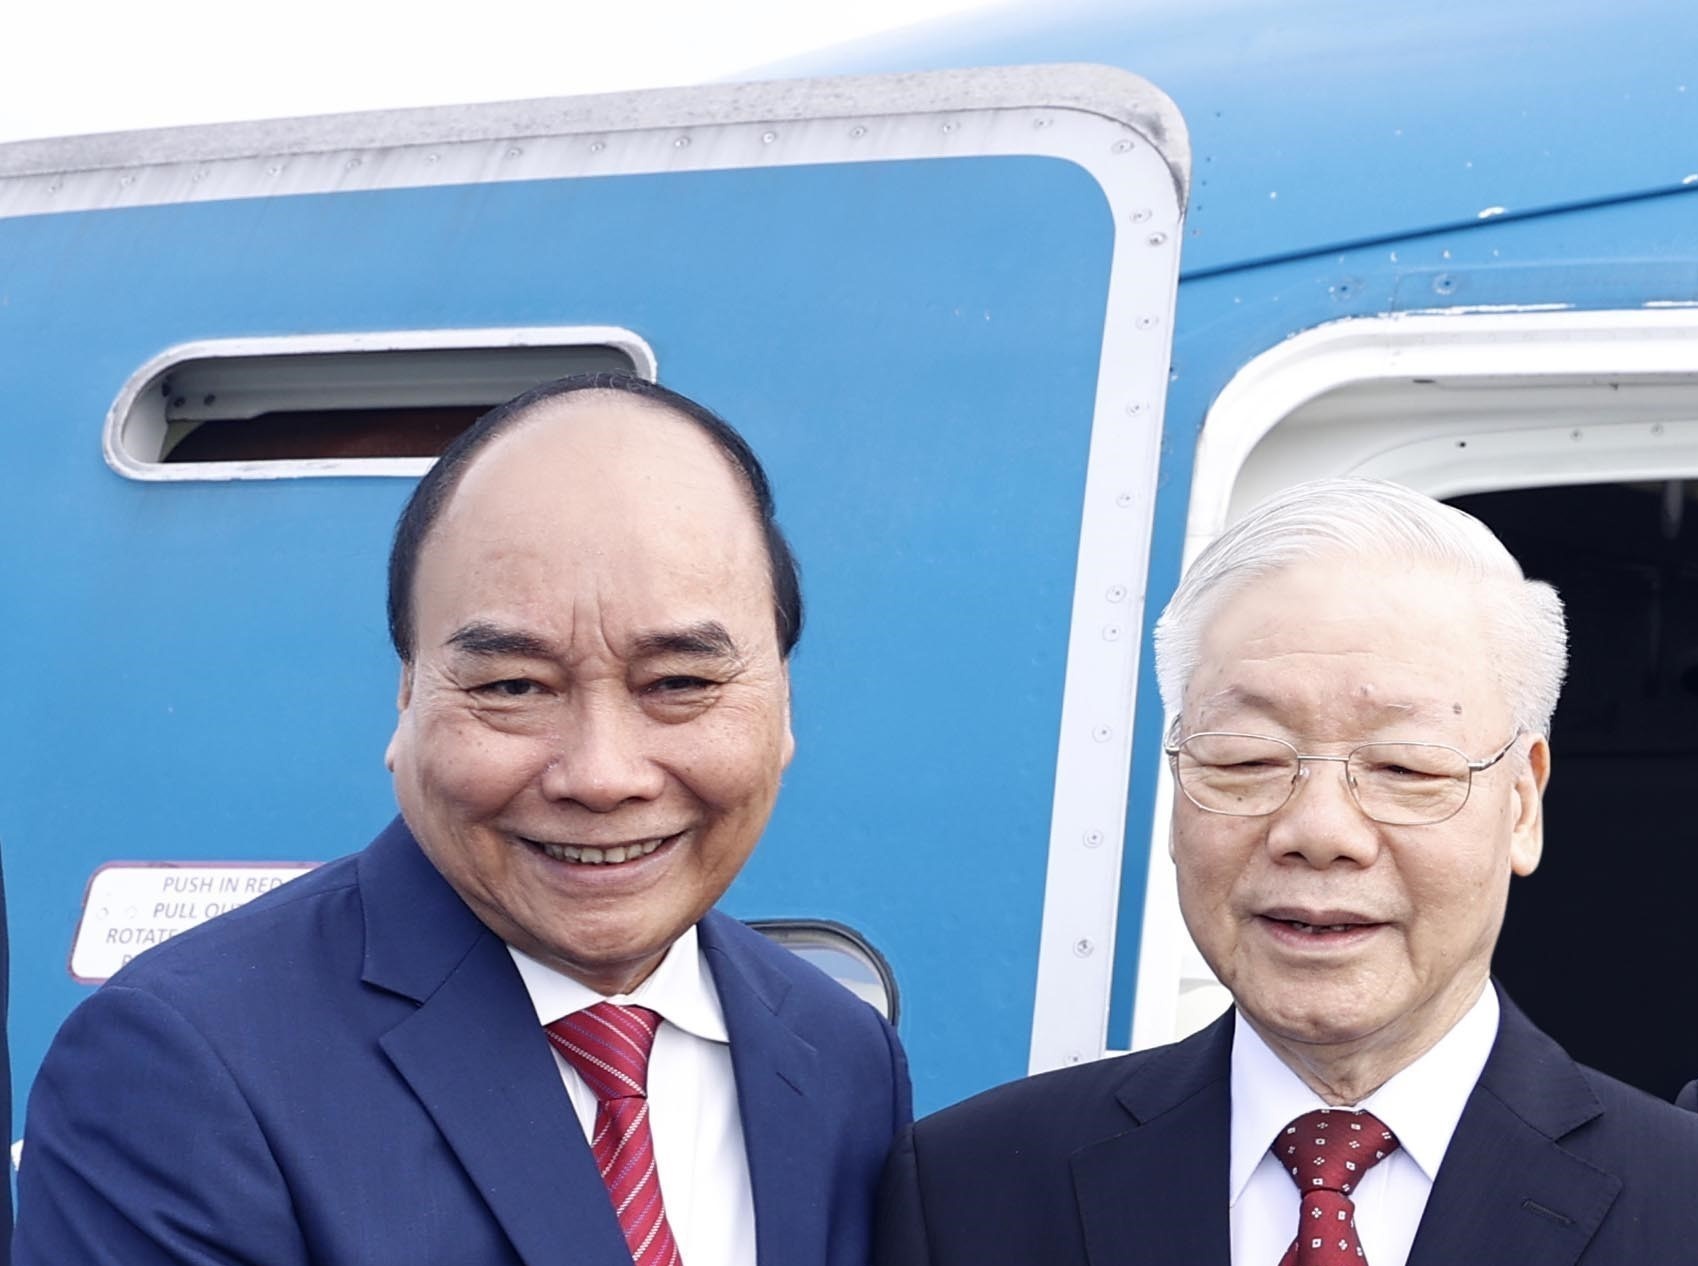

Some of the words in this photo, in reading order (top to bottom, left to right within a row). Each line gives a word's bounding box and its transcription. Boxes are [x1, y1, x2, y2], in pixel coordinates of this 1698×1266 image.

[162, 877, 214, 893] PUSH
[219, 877, 239, 893] IN
[152, 902, 196, 919] PULL
